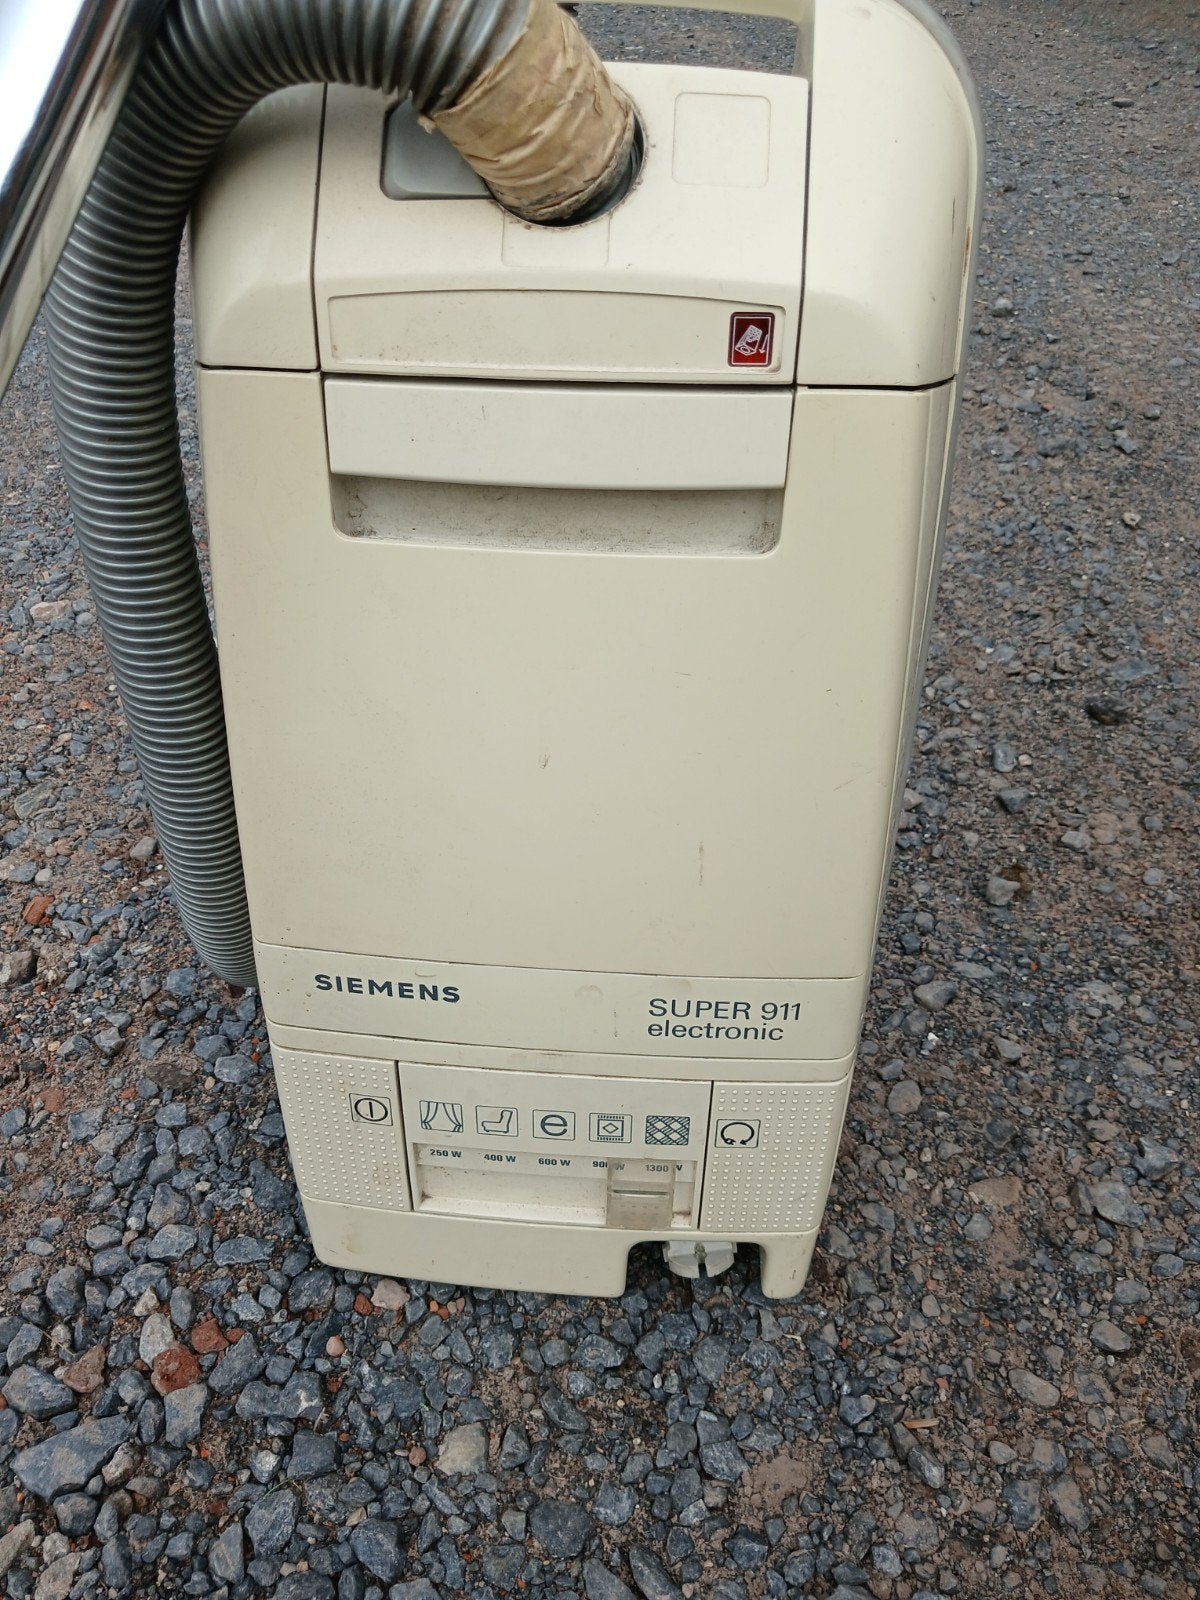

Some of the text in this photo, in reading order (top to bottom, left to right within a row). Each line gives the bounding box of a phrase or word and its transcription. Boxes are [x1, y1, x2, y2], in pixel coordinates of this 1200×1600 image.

[314, 973, 461, 1004] SIEMENS
[648, 998, 801, 1021] SUPER 911
[647, 1019, 785, 1041] electronic
[429, 1148, 462, 1158] 250 W
[483, 1153, 517, 1163] 400 W
[538, 1157, 571, 1167] 600 W
[645, 1164, 669, 1173] 1300
